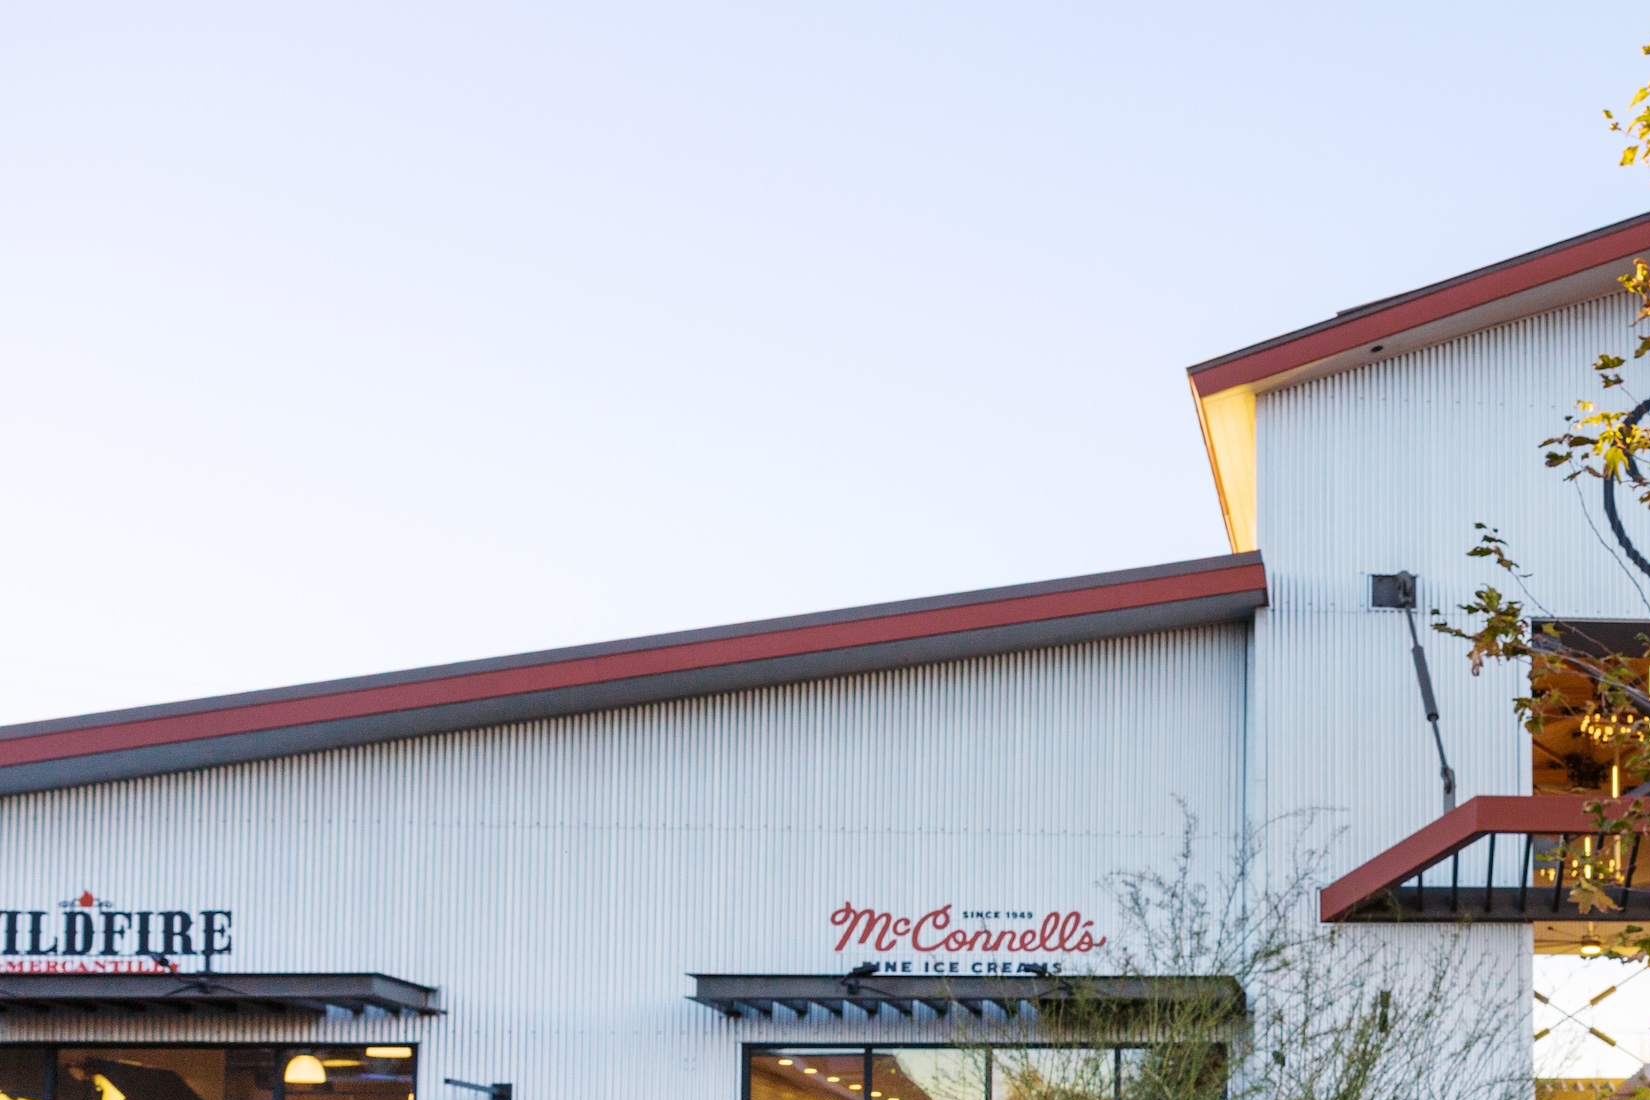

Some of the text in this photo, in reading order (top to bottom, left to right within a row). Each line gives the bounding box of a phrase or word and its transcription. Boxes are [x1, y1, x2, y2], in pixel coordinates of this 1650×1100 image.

[830, 901, 1107, 953] McConnell's
[962, 911, 1034, 920] SINCE 1949
[0, 911, 232, 956] ILDFIRE
[924, 961, 960, 974] ICE
[971, 961, 1063, 975] CREAS
